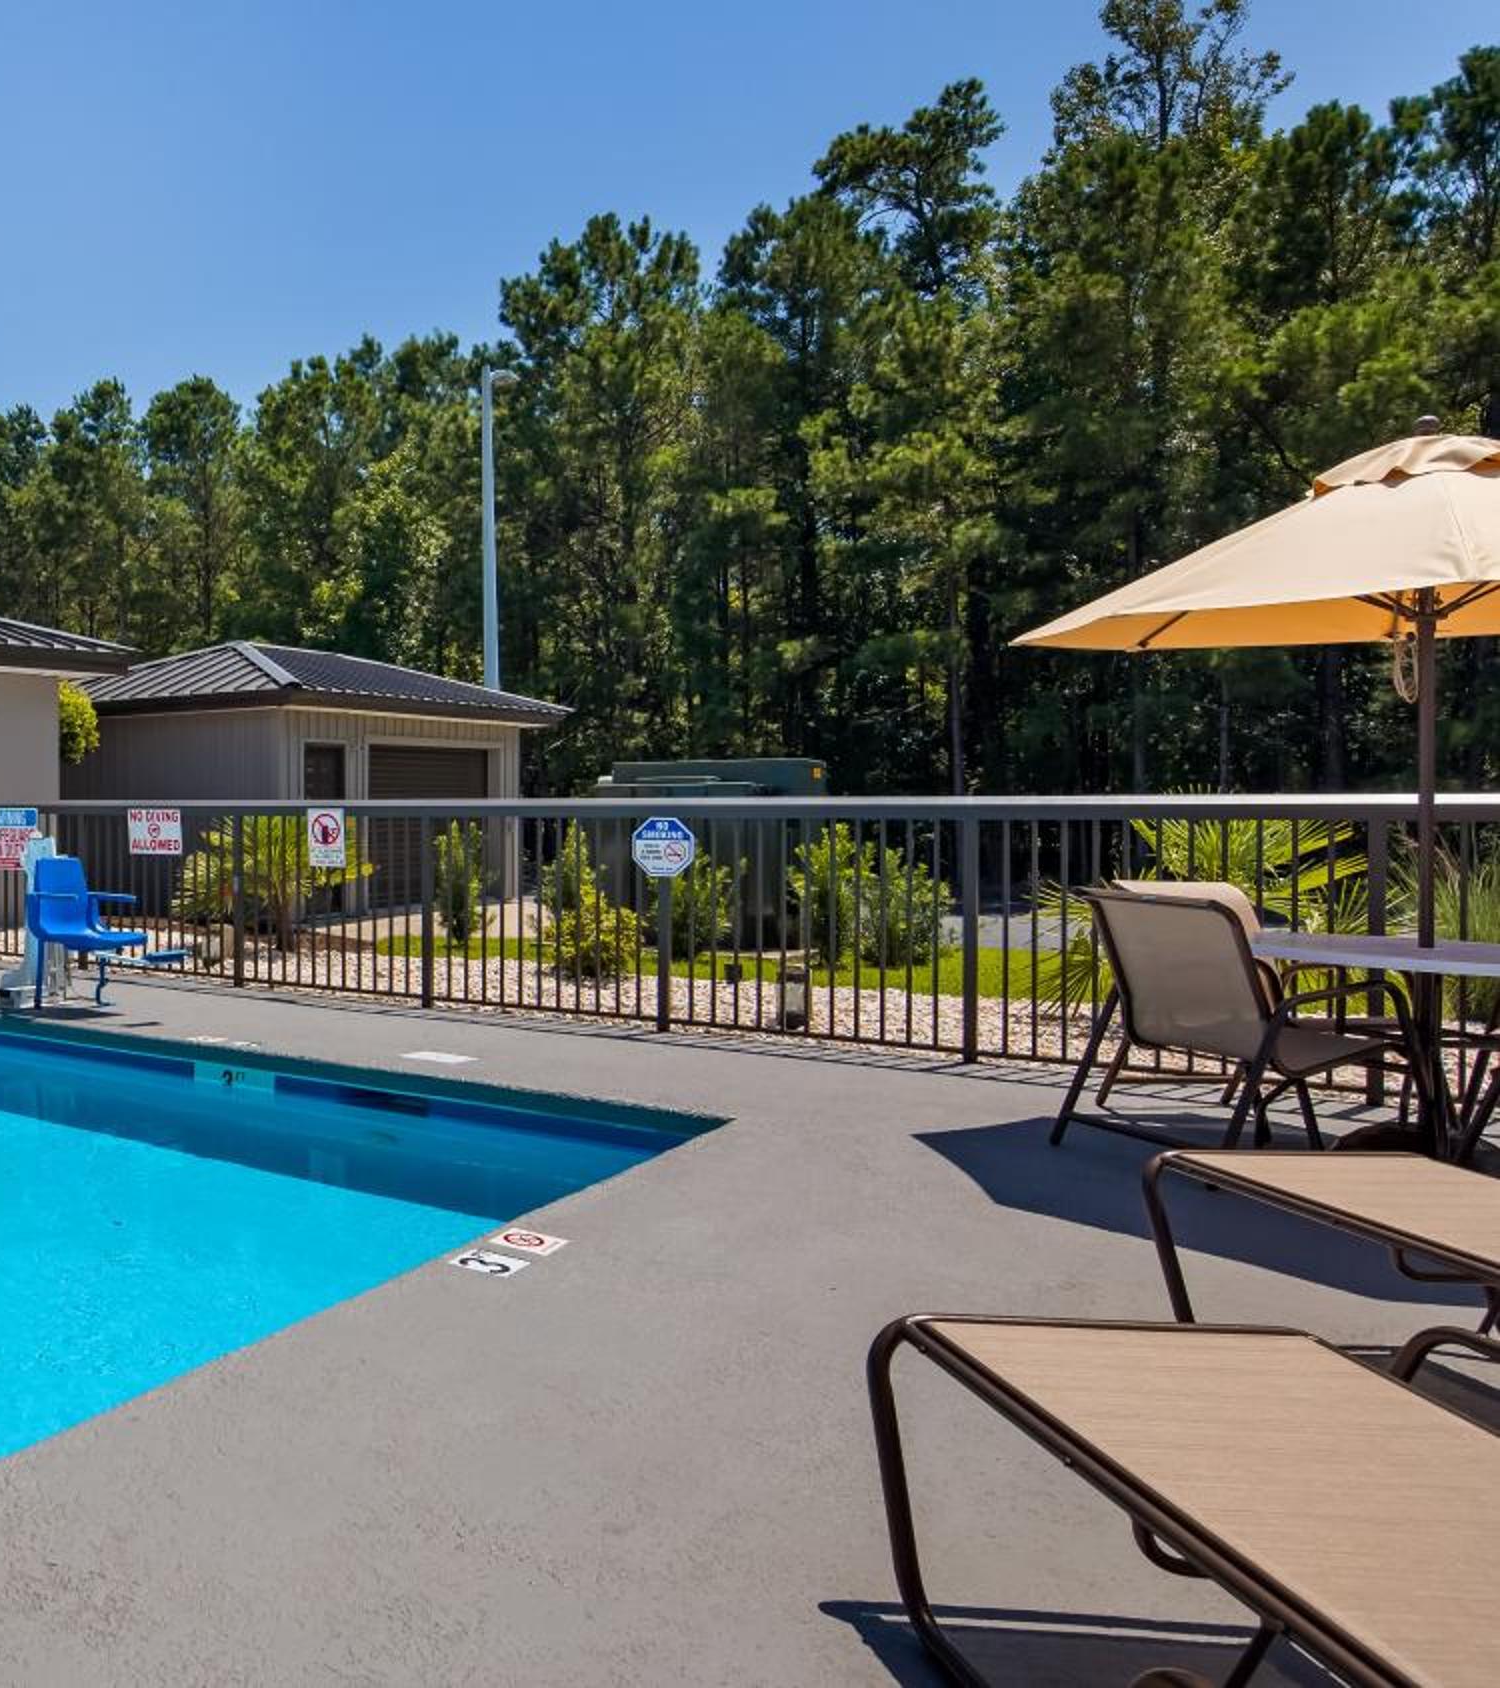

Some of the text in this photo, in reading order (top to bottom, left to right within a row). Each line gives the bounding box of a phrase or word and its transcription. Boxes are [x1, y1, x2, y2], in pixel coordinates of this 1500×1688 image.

[130, 810, 179, 823] NO DIVING
[655, 821, 669, 831] NO
[641, 830, 684, 839] SMOKING
[132, 839, 180, 851] ALLOWED
